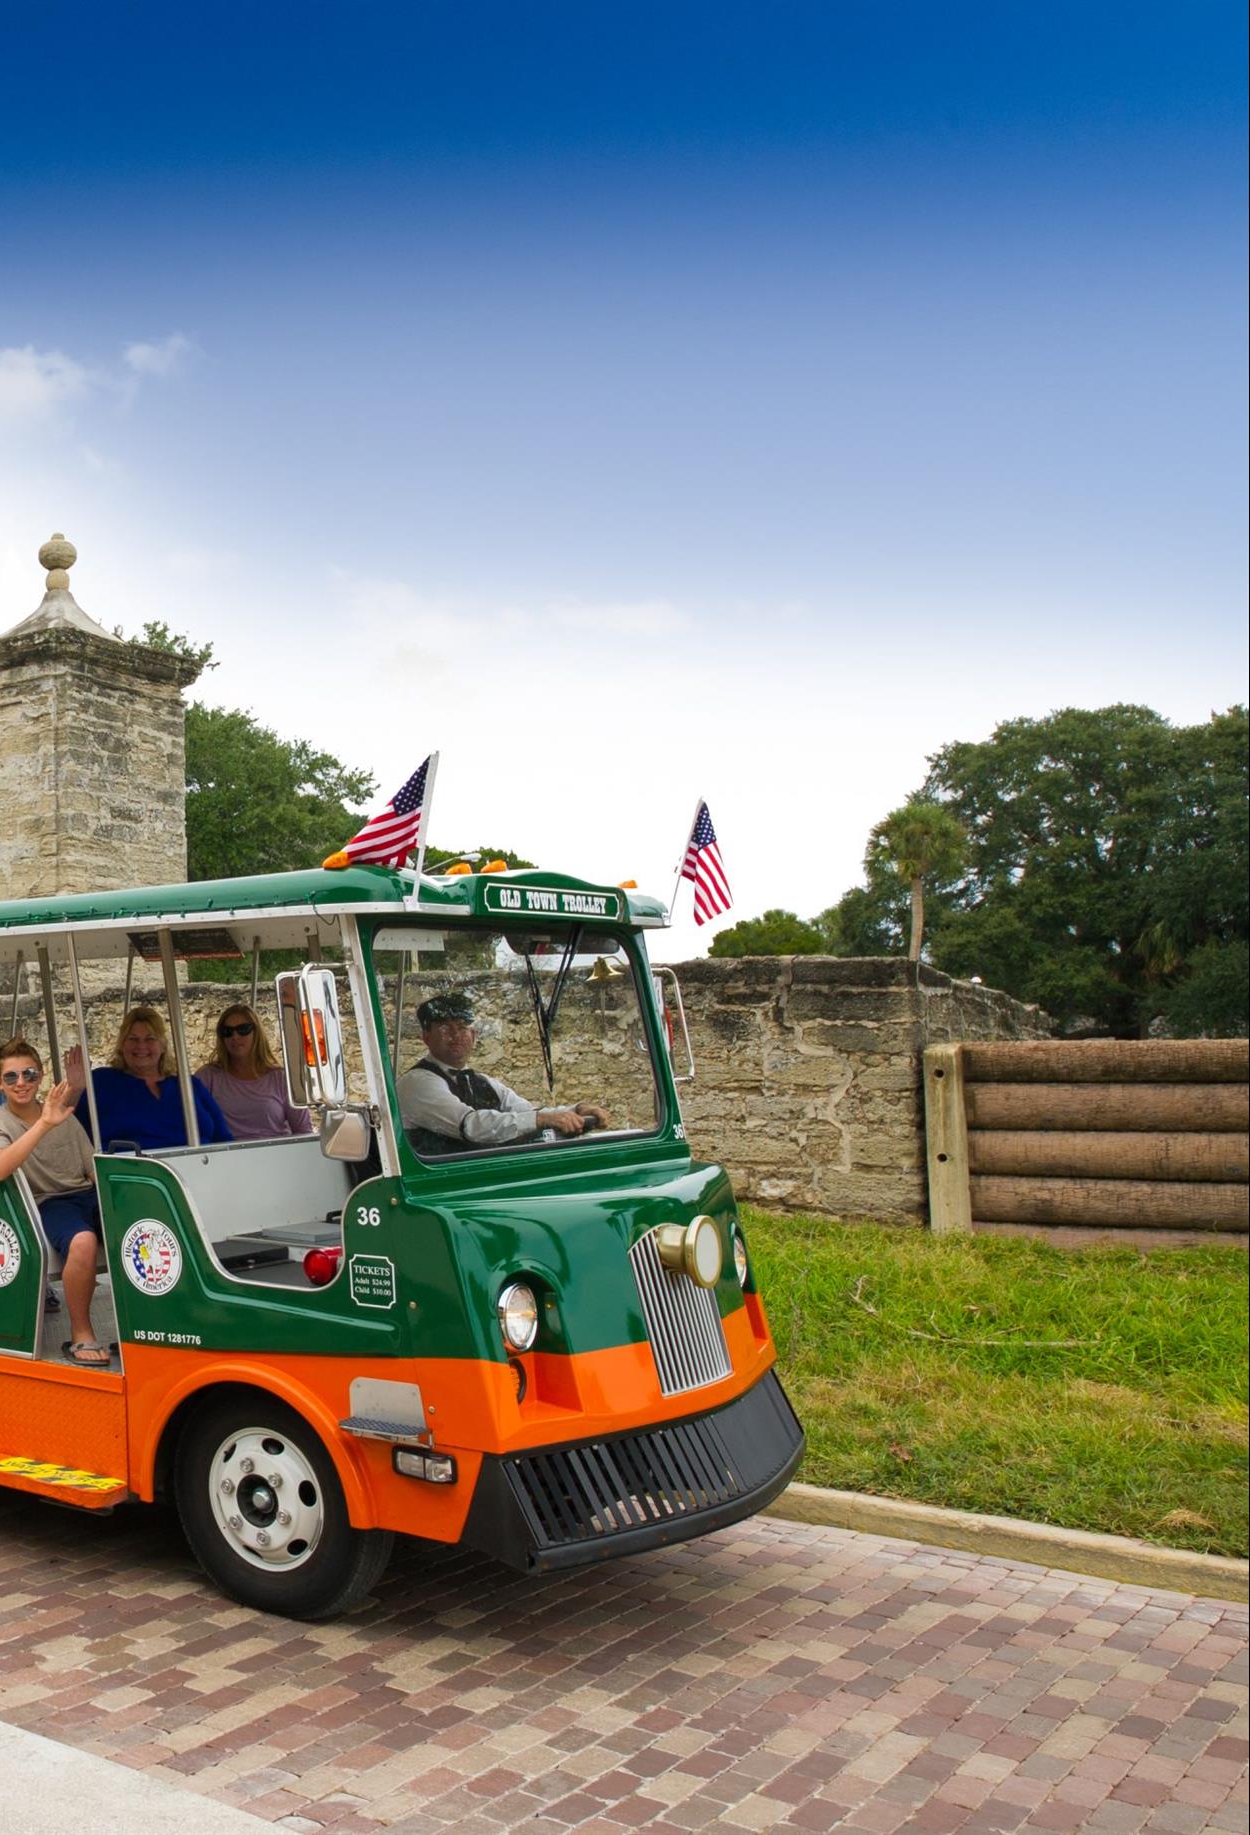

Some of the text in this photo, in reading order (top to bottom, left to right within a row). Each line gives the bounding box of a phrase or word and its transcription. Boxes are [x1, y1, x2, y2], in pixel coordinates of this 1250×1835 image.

[500, 889, 607, 914] OLD TOWN TROLLEY
[672, 1124, 684, 1139] 36
[356, 1206, 381, 1227] 36
[353, 1265, 390, 1277] TICKETS
[134, 1330, 202, 1345] US DOT 1281776
